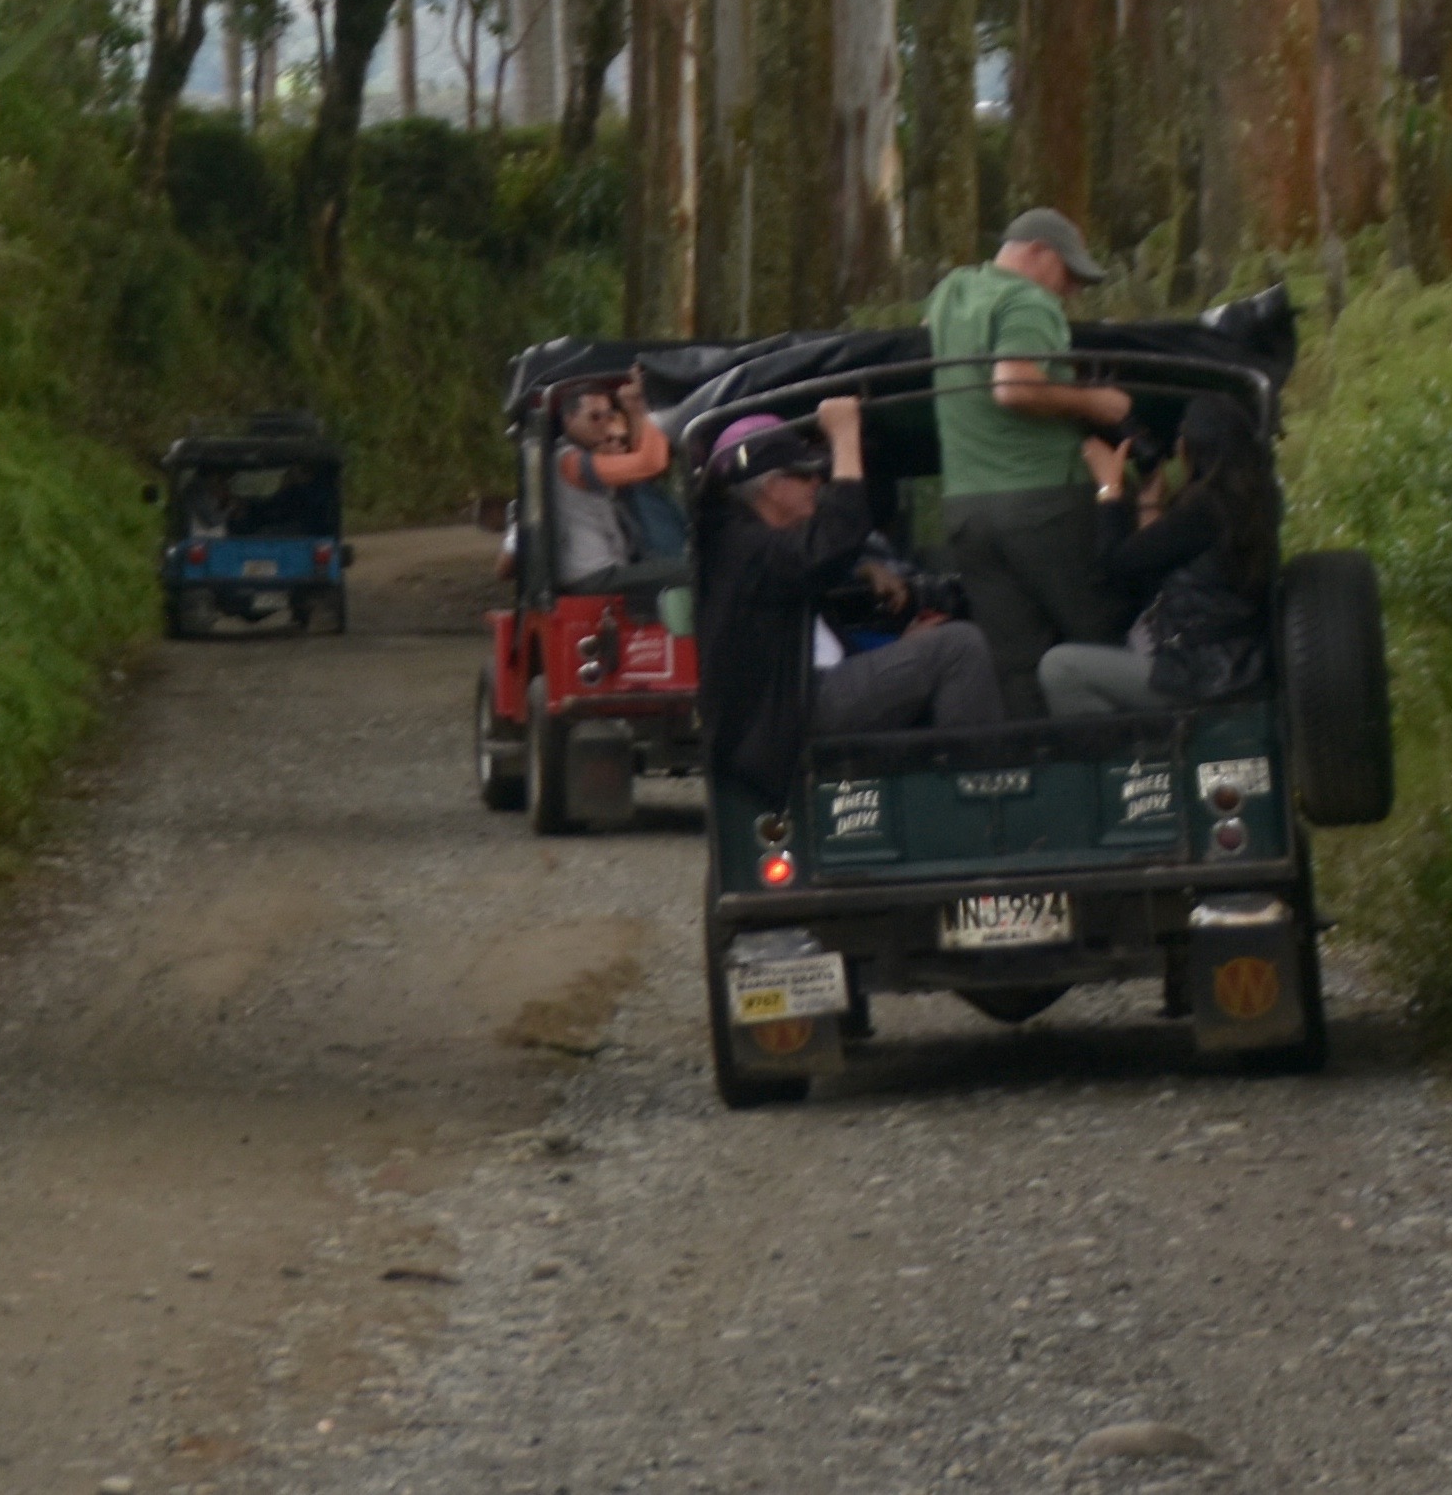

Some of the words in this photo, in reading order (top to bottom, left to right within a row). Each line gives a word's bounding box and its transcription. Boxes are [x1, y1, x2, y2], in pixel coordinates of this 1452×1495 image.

[1122, 773, 1170, 799] WHEEL
[832, 790, 879, 816] WHEEL
[1126, 792, 1172, 820] DRIVE
[836, 810, 880, 836] DRIVE
